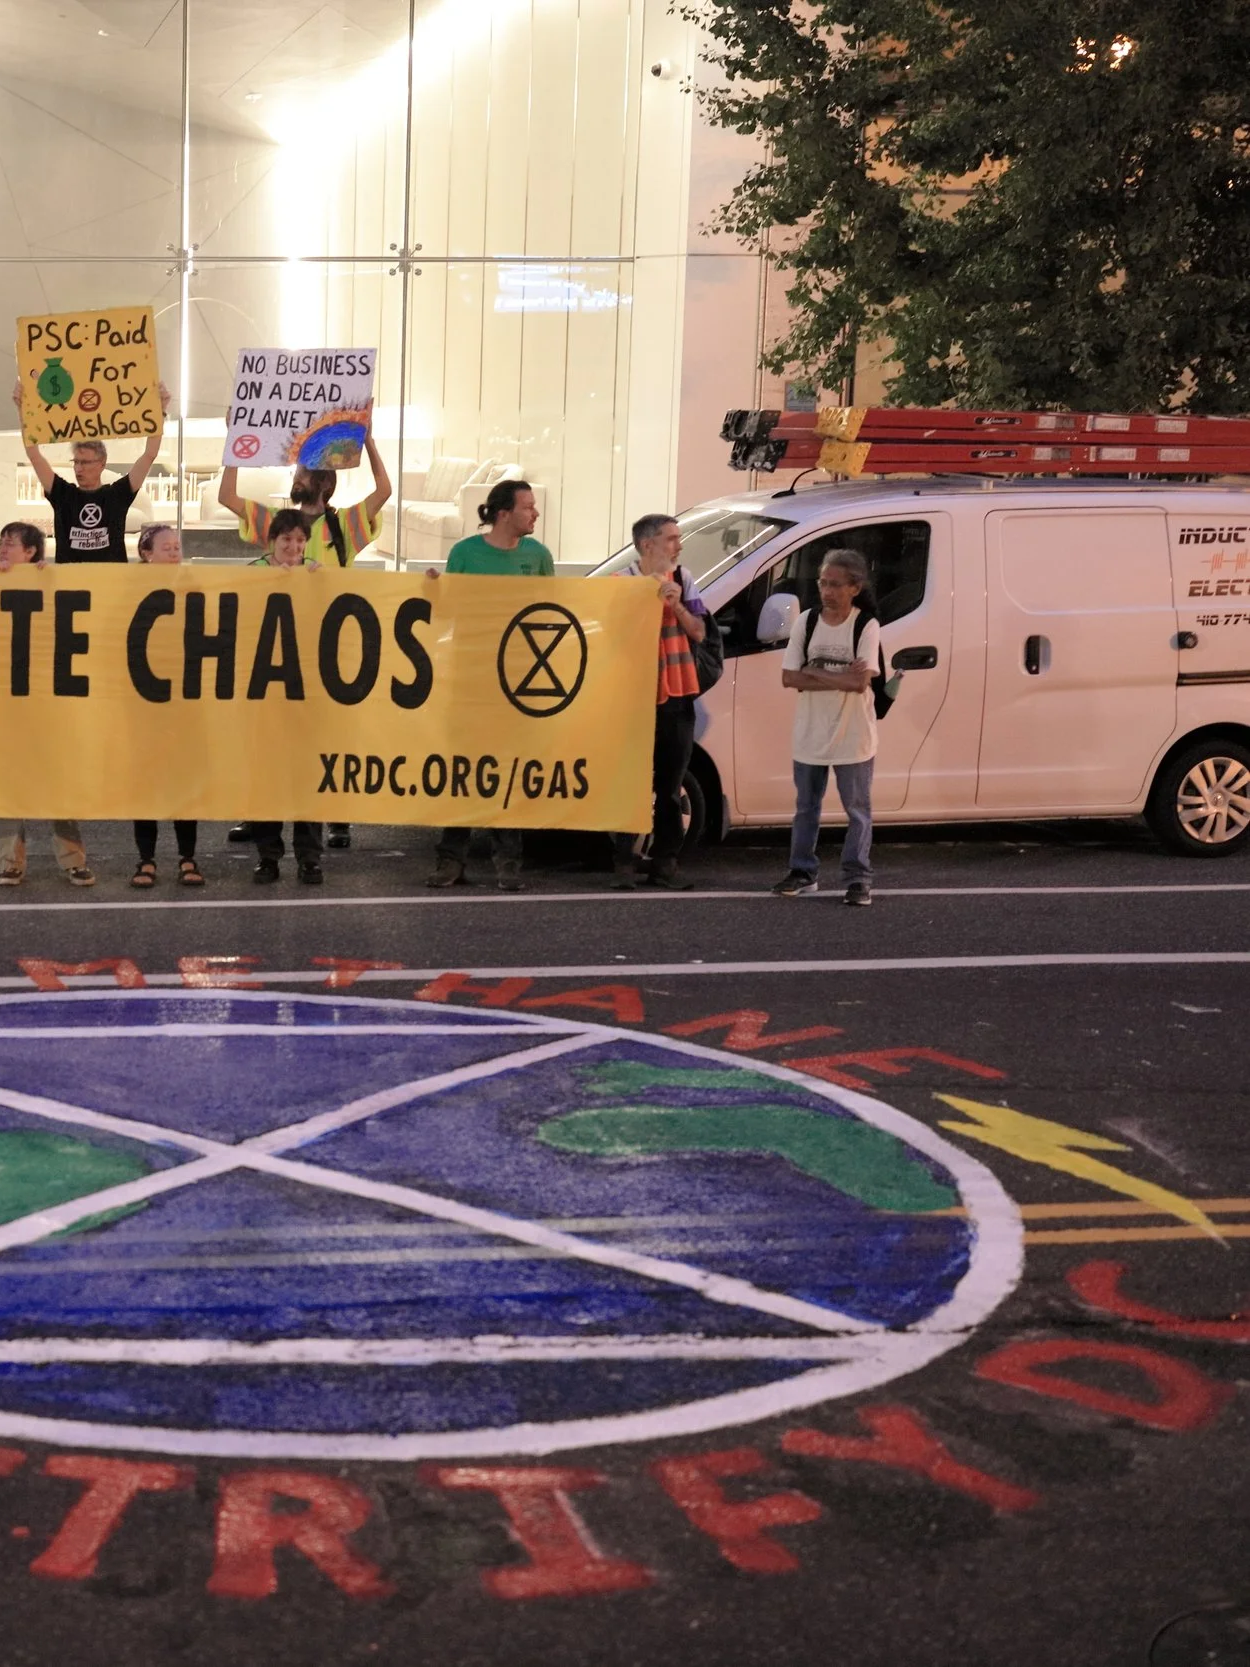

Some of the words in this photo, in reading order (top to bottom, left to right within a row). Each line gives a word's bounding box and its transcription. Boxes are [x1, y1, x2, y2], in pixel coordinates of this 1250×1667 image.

[28, 321, 88, 352] PSC:
[95, 315, 148, 347] Paid
[90, 357, 137, 383] For
[242, 355, 267, 375] NO
[276, 354, 371, 376] BUSINESS
[117, 385, 147, 406] by
[236, 381, 263, 400] ON
[269, 382, 282, 400] A
[289, 382, 342, 403] DEAD
[233, 406, 318, 429] PLANET
[1178, 527, 1250, 545] INDUC
[126, 589, 435, 710] CHAOS
[317, 752, 589, 810] XRDC.ORG/GAS
[16, 956, 1009, 1093] METHANE
